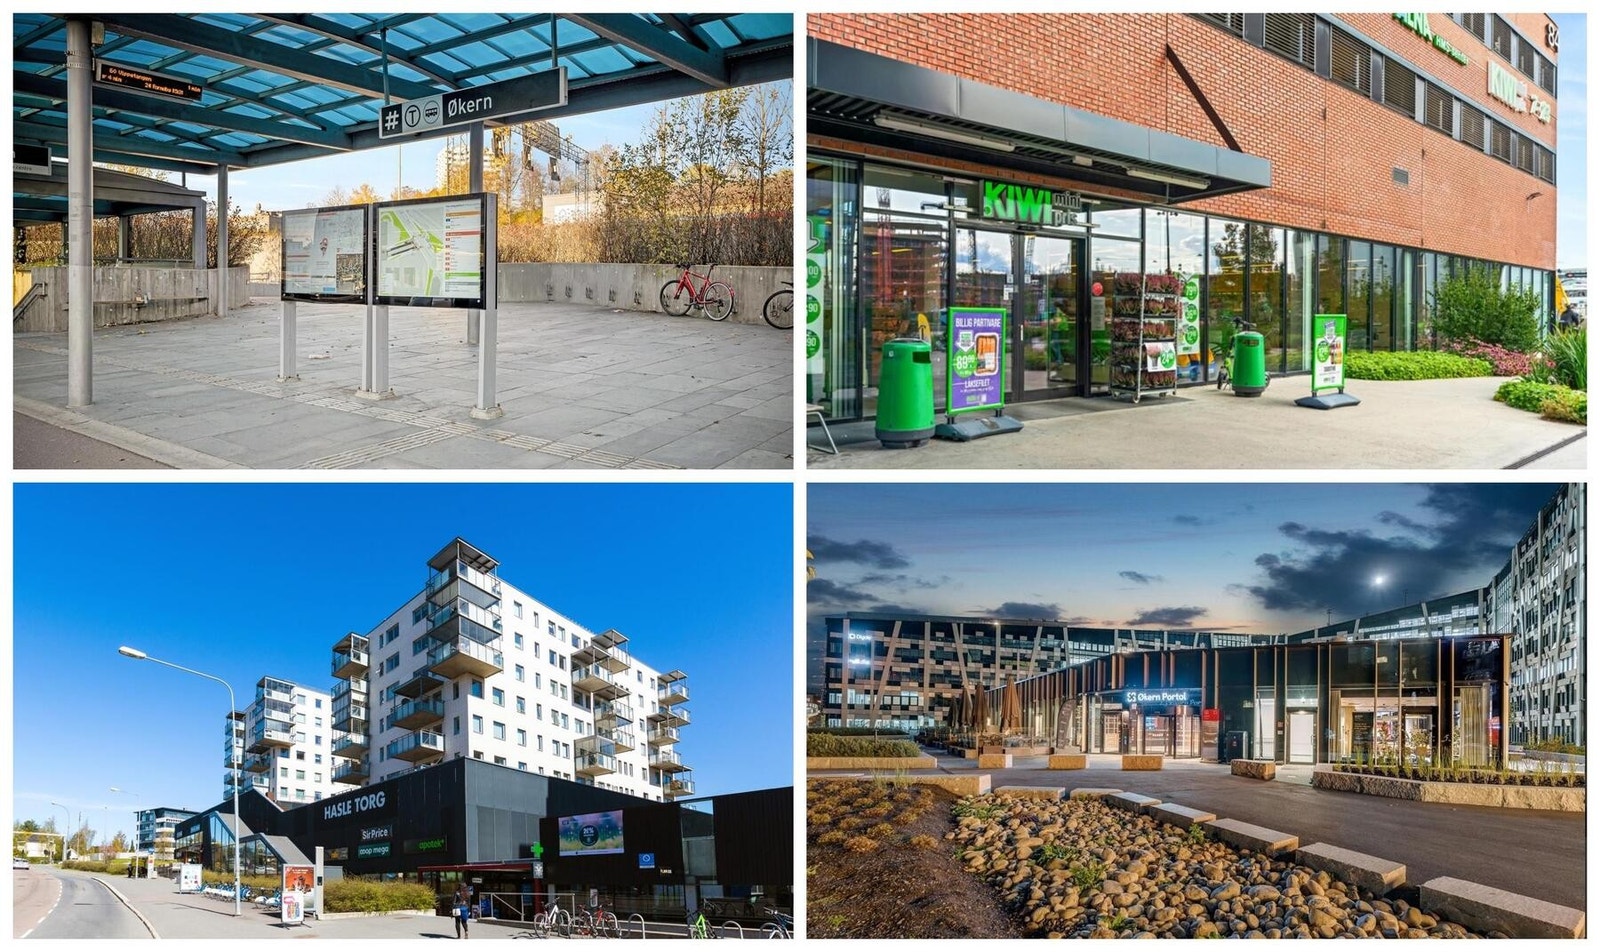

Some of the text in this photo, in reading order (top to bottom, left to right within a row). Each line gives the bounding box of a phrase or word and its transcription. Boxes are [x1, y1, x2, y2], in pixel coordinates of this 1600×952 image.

[1394, 13, 1432, 41] NA
[1491, 61, 1516, 105] KIWI
[447, 96, 493, 118] Økern
[983, 181, 1081, 225] KIWI mini
[1054, 209, 1079, 226] pris
[955, 317, 972, 328] BILLIG
[1137, 692, 1187, 702] Økern Portal
[324, 791, 386, 820] HASLE TORG
[360, 846, 389, 857] coop mega
